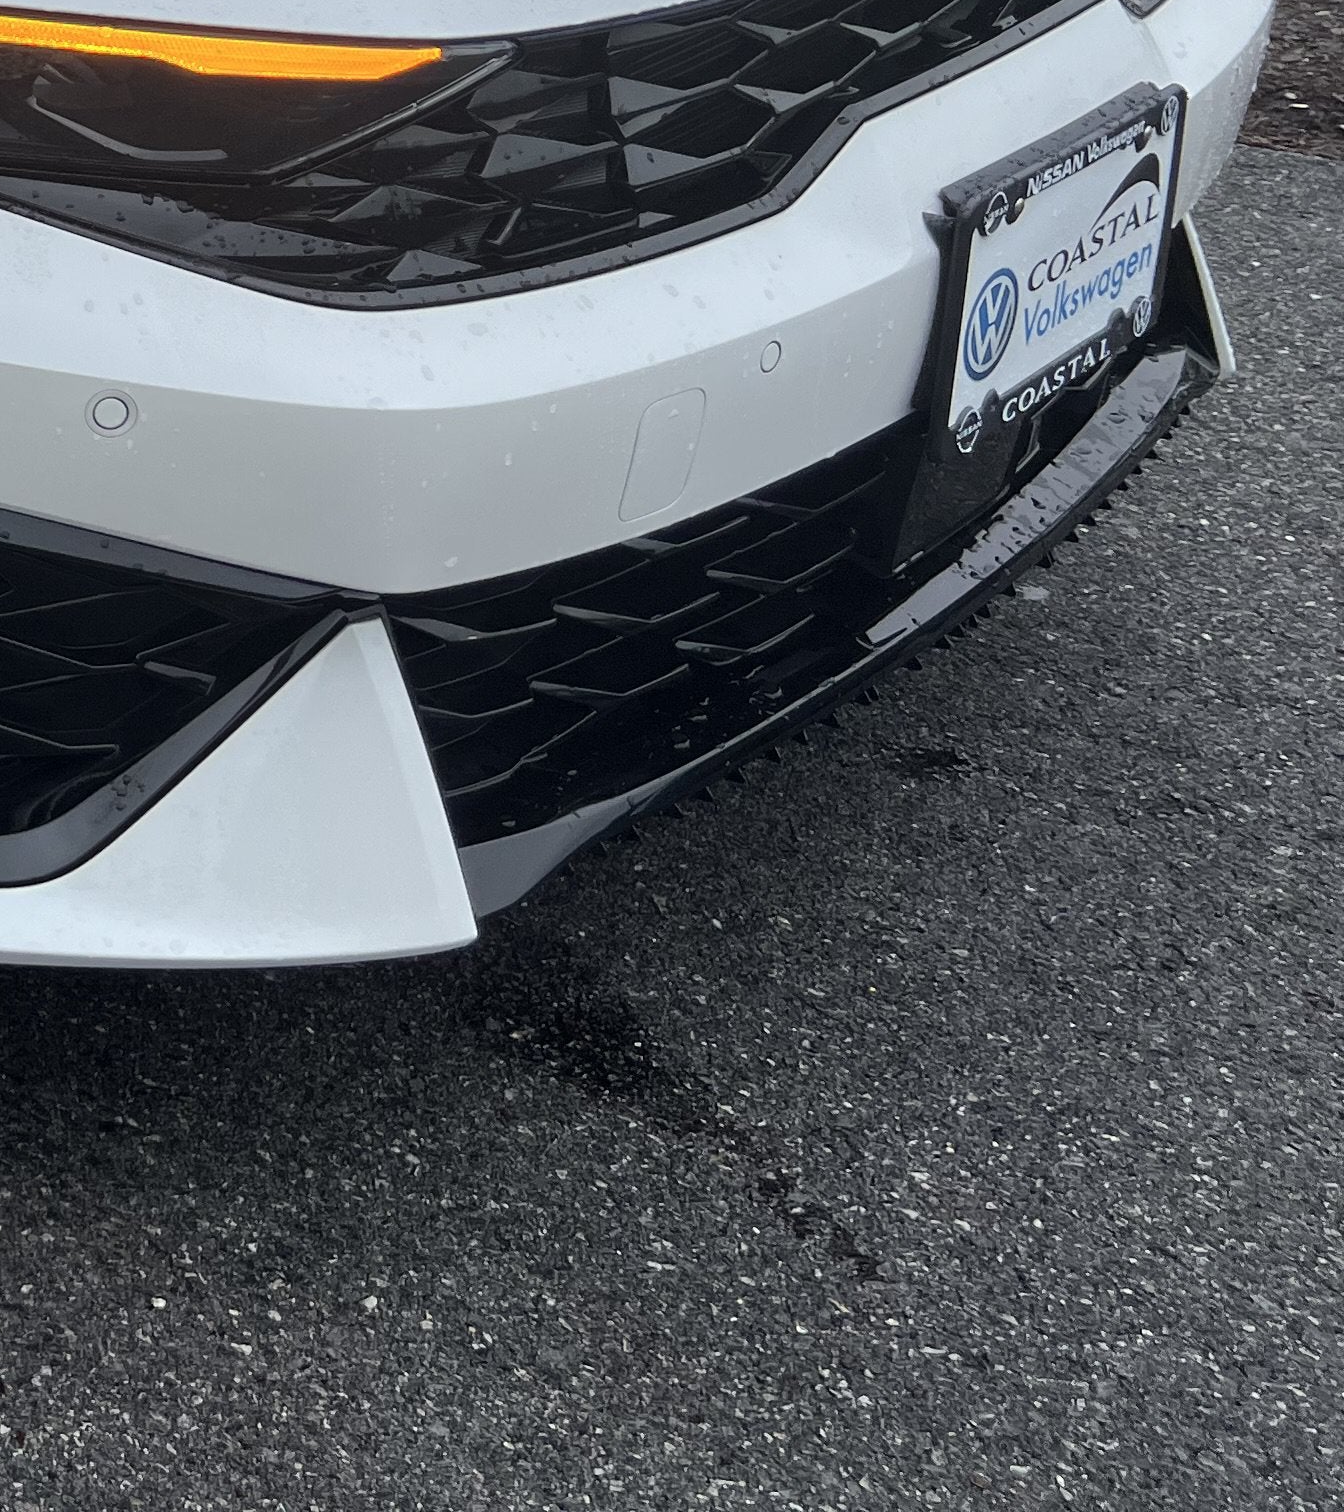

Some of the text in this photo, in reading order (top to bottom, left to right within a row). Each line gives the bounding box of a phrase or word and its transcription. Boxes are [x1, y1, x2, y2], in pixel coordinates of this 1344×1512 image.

[1027, 150, 1085, 197] NISSAN
[1027, 193, 1159, 292] COASTAL
[1024, 242, 1153, 345] Volkswagen
[1002, 338, 1111, 422] COASTAL
